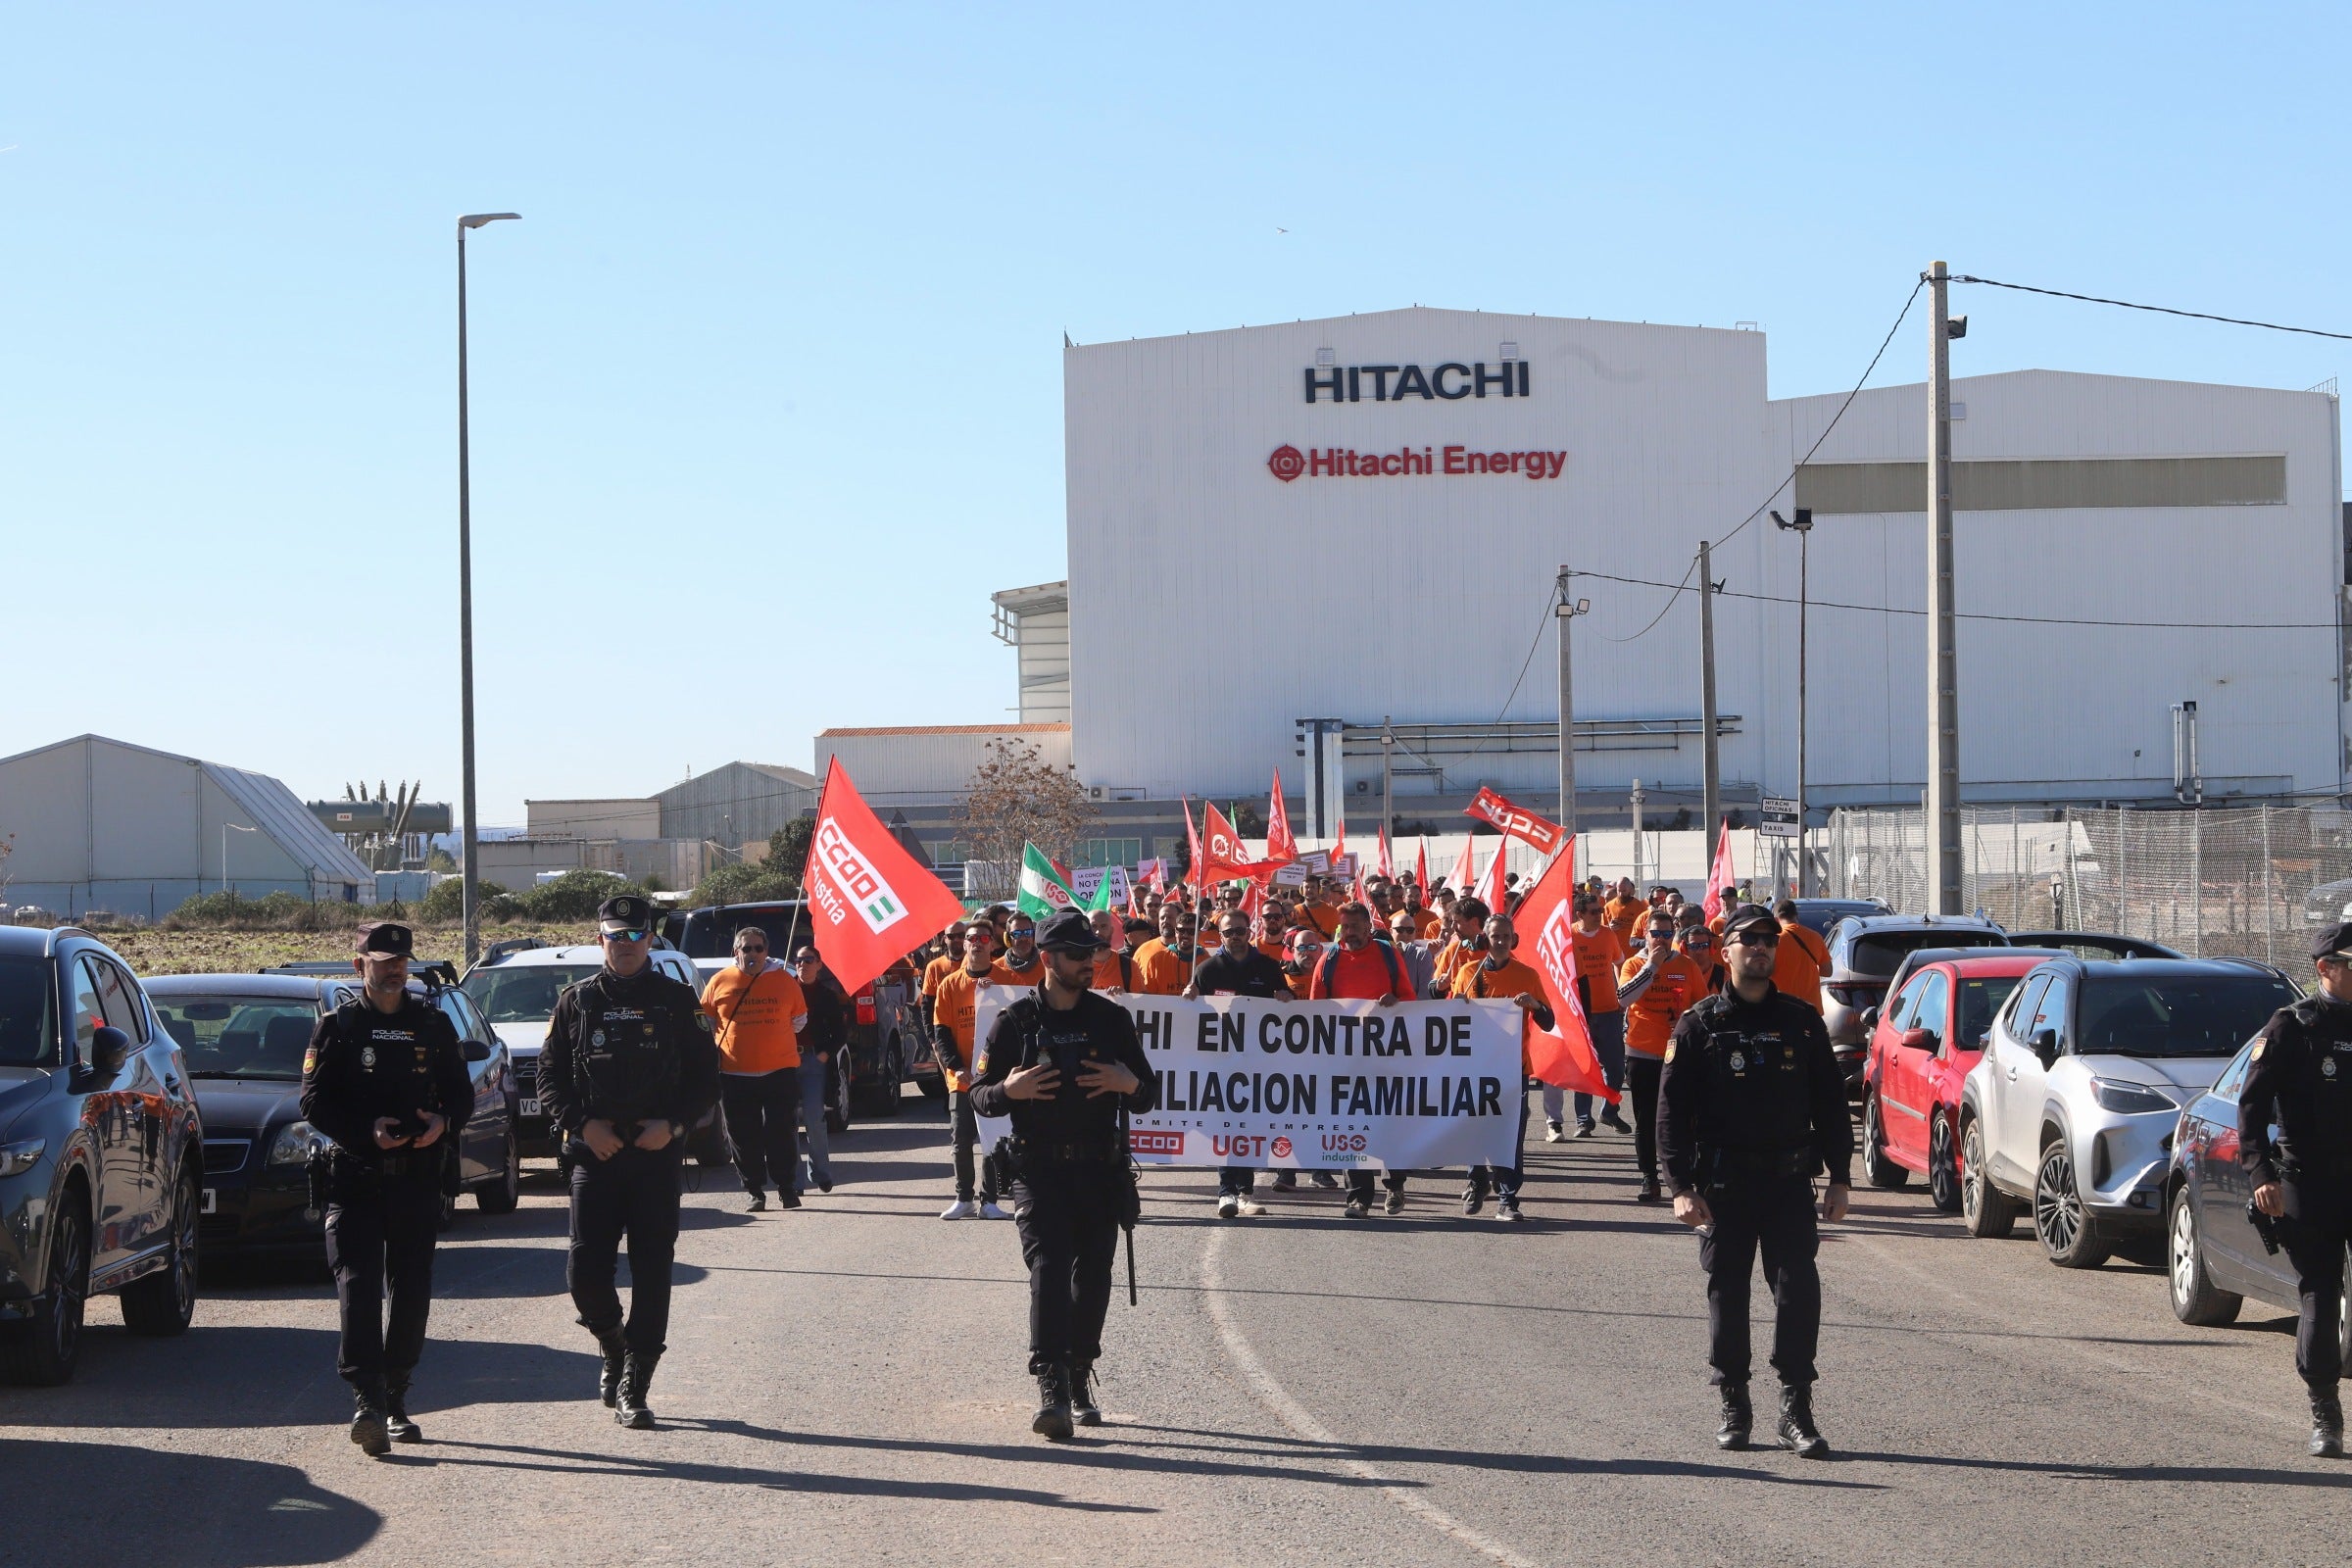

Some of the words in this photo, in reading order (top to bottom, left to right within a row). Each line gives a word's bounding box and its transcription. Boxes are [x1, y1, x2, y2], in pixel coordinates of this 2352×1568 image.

[1304, 361, 1530, 403] HITACHI
[1310, 446, 1433, 476] Hitachi
[1444, 445, 1567, 479] Energy
[819, 825, 880, 902] CCOO
[811, 852, 846, 926] ustria
[957, 1005, 976, 1016] HIT
[1135, 1010, 1173, 1051] HI
[1198, 1012, 1246, 1053] EN
[1258, 1013, 1412, 1056] CONTRA
[1425, 1015, 1472, 1056] DE
[521, 1100, 538, 1113] VC
[1330, 1075, 1503, 1117] FAMILIAR
[1135, 1118, 1204, 1127] OMITE
[1212, 1134, 1267, 1157] UGT
[1321, 1134, 1368, 1152] USO
[1322, 1152, 1368, 1162] industria
